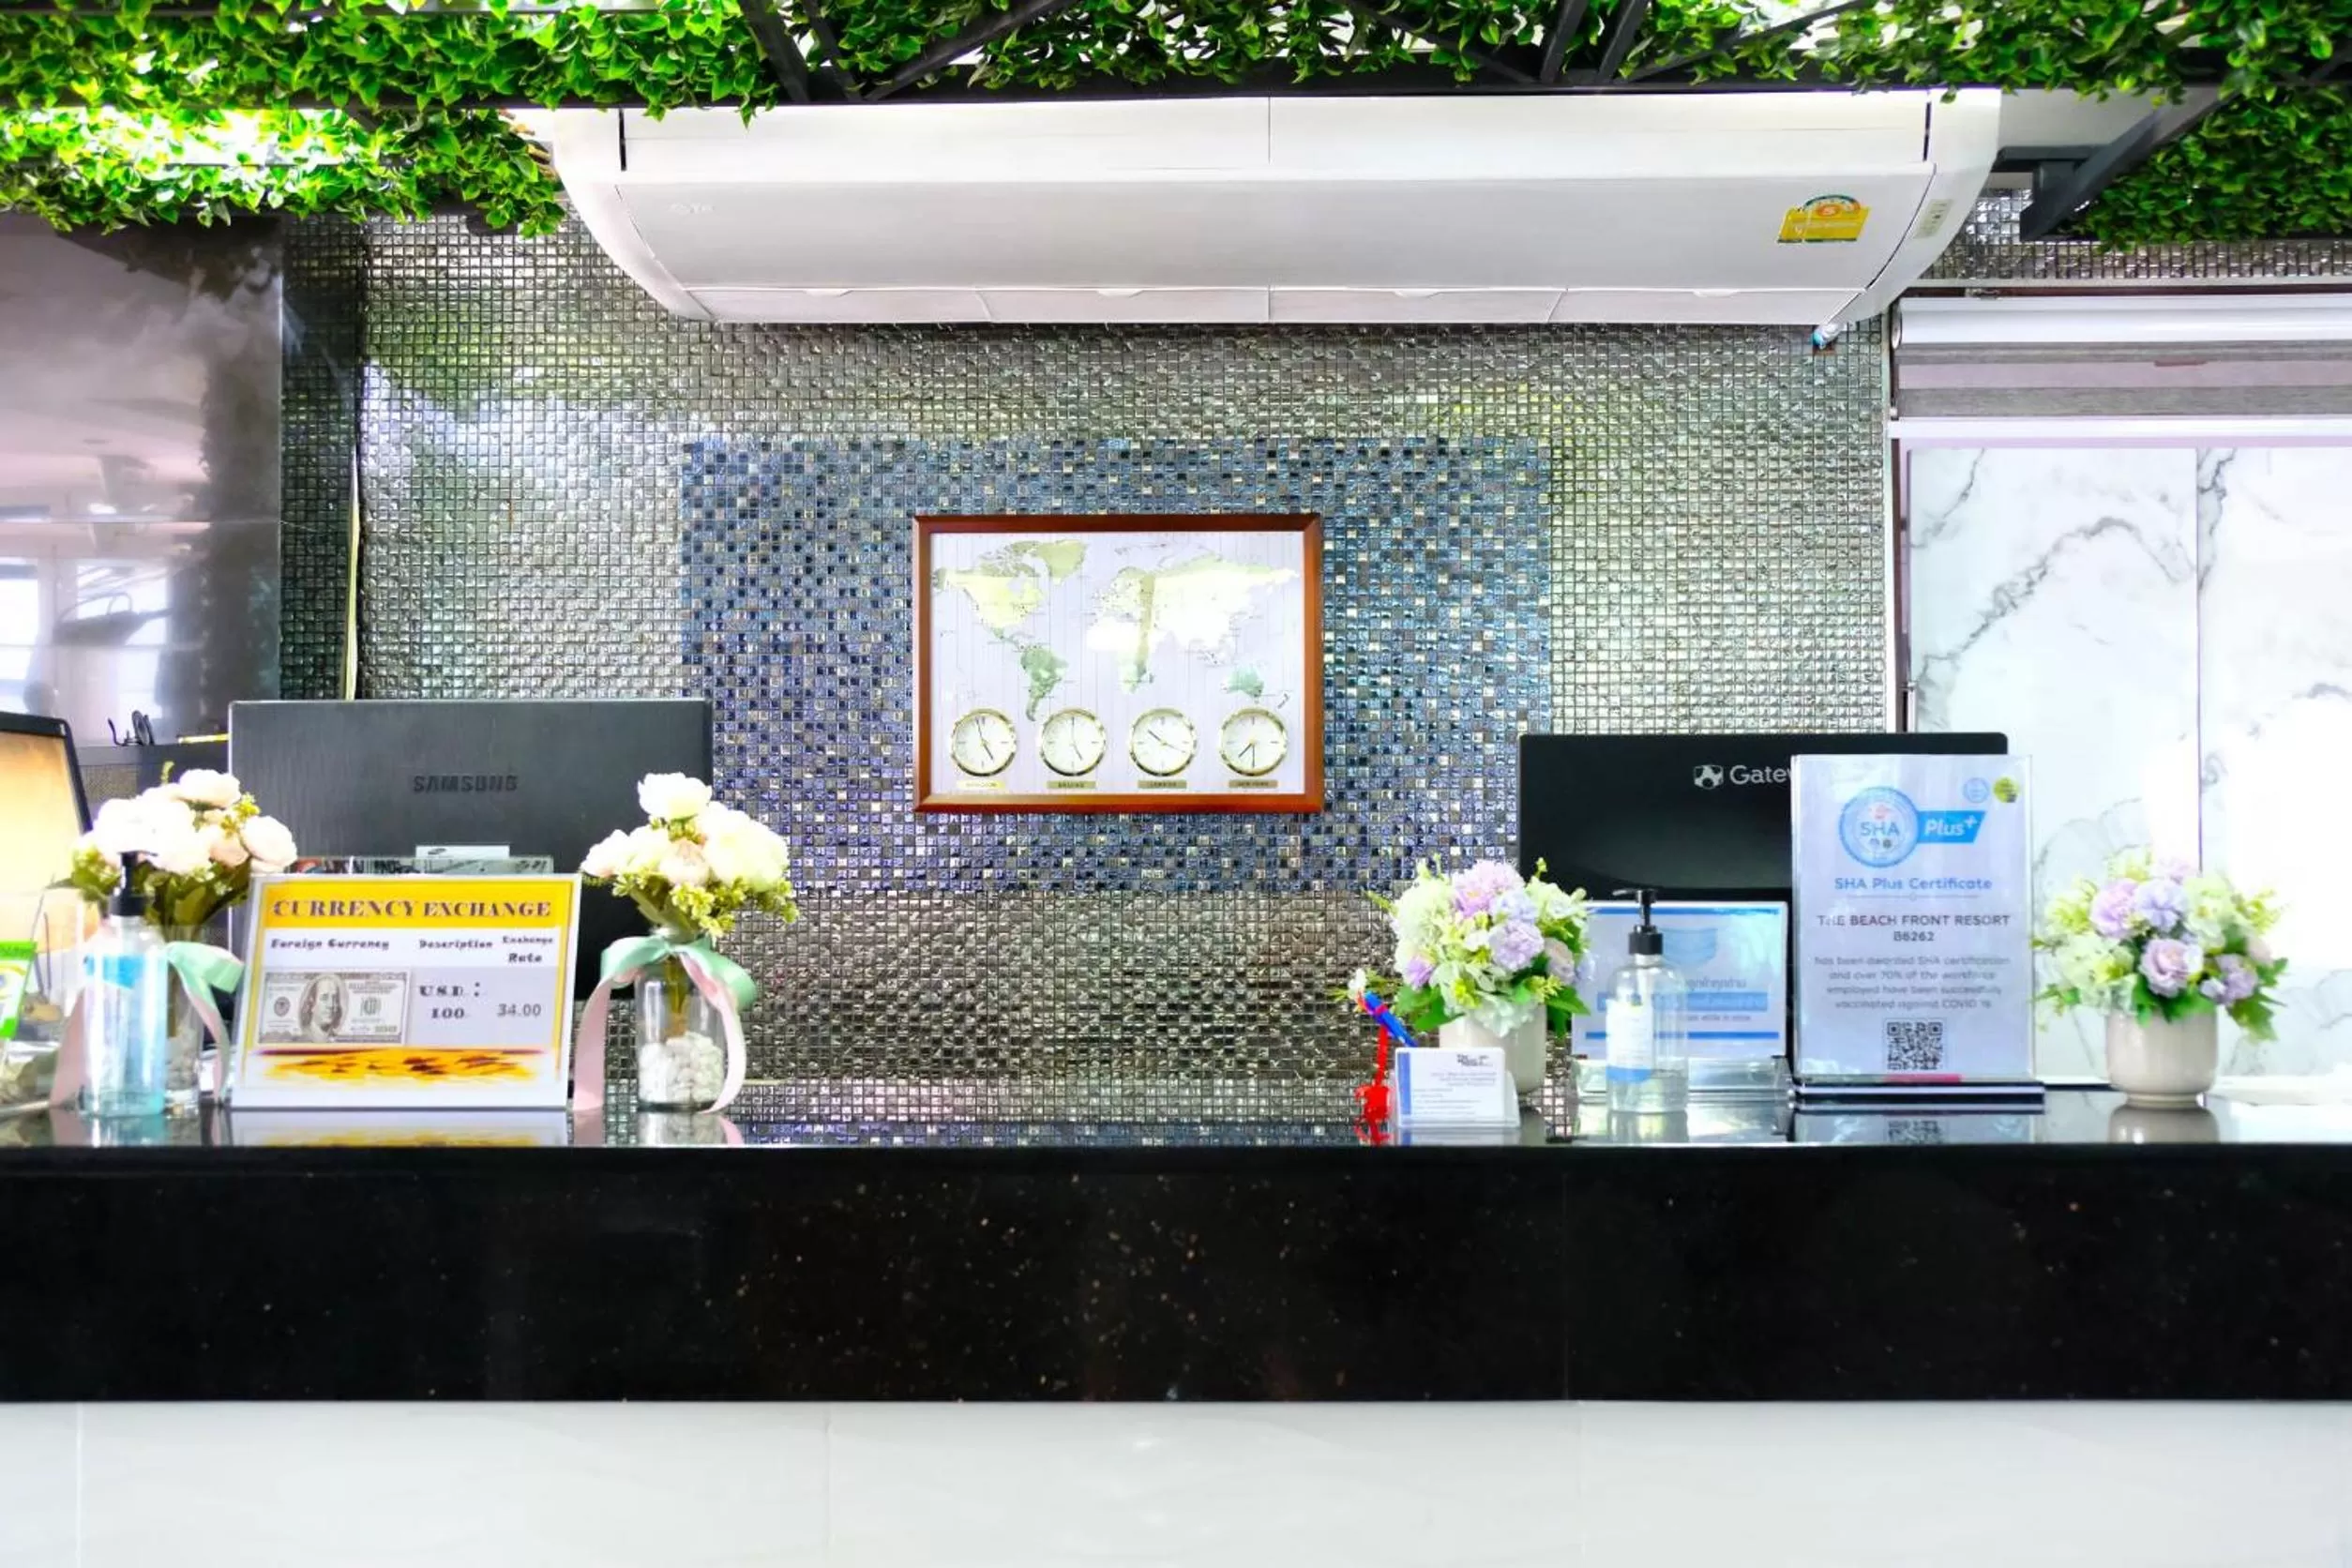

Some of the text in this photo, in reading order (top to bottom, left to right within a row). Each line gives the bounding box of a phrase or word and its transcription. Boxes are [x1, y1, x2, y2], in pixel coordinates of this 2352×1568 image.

[414, 775, 519, 793] SAMSUNG
[1860, 821, 1900, 837] SHA
[1834, 877, 1993, 890] SHA Plus Certificate
[273, 899, 551, 917] CURRENCY EXCHANGE
[1849, 914, 1897, 927] BEACH
[1902, 914, 1950, 927] FRONT
[1954, 914, 2011, 927] RESORT
[271, 938, 389, 950] Foreign Currency
[419, 940, 493, 950] Description
[430, 1007, 465, 1019] 100
[497, 1003, 543, 1018] 34.00
